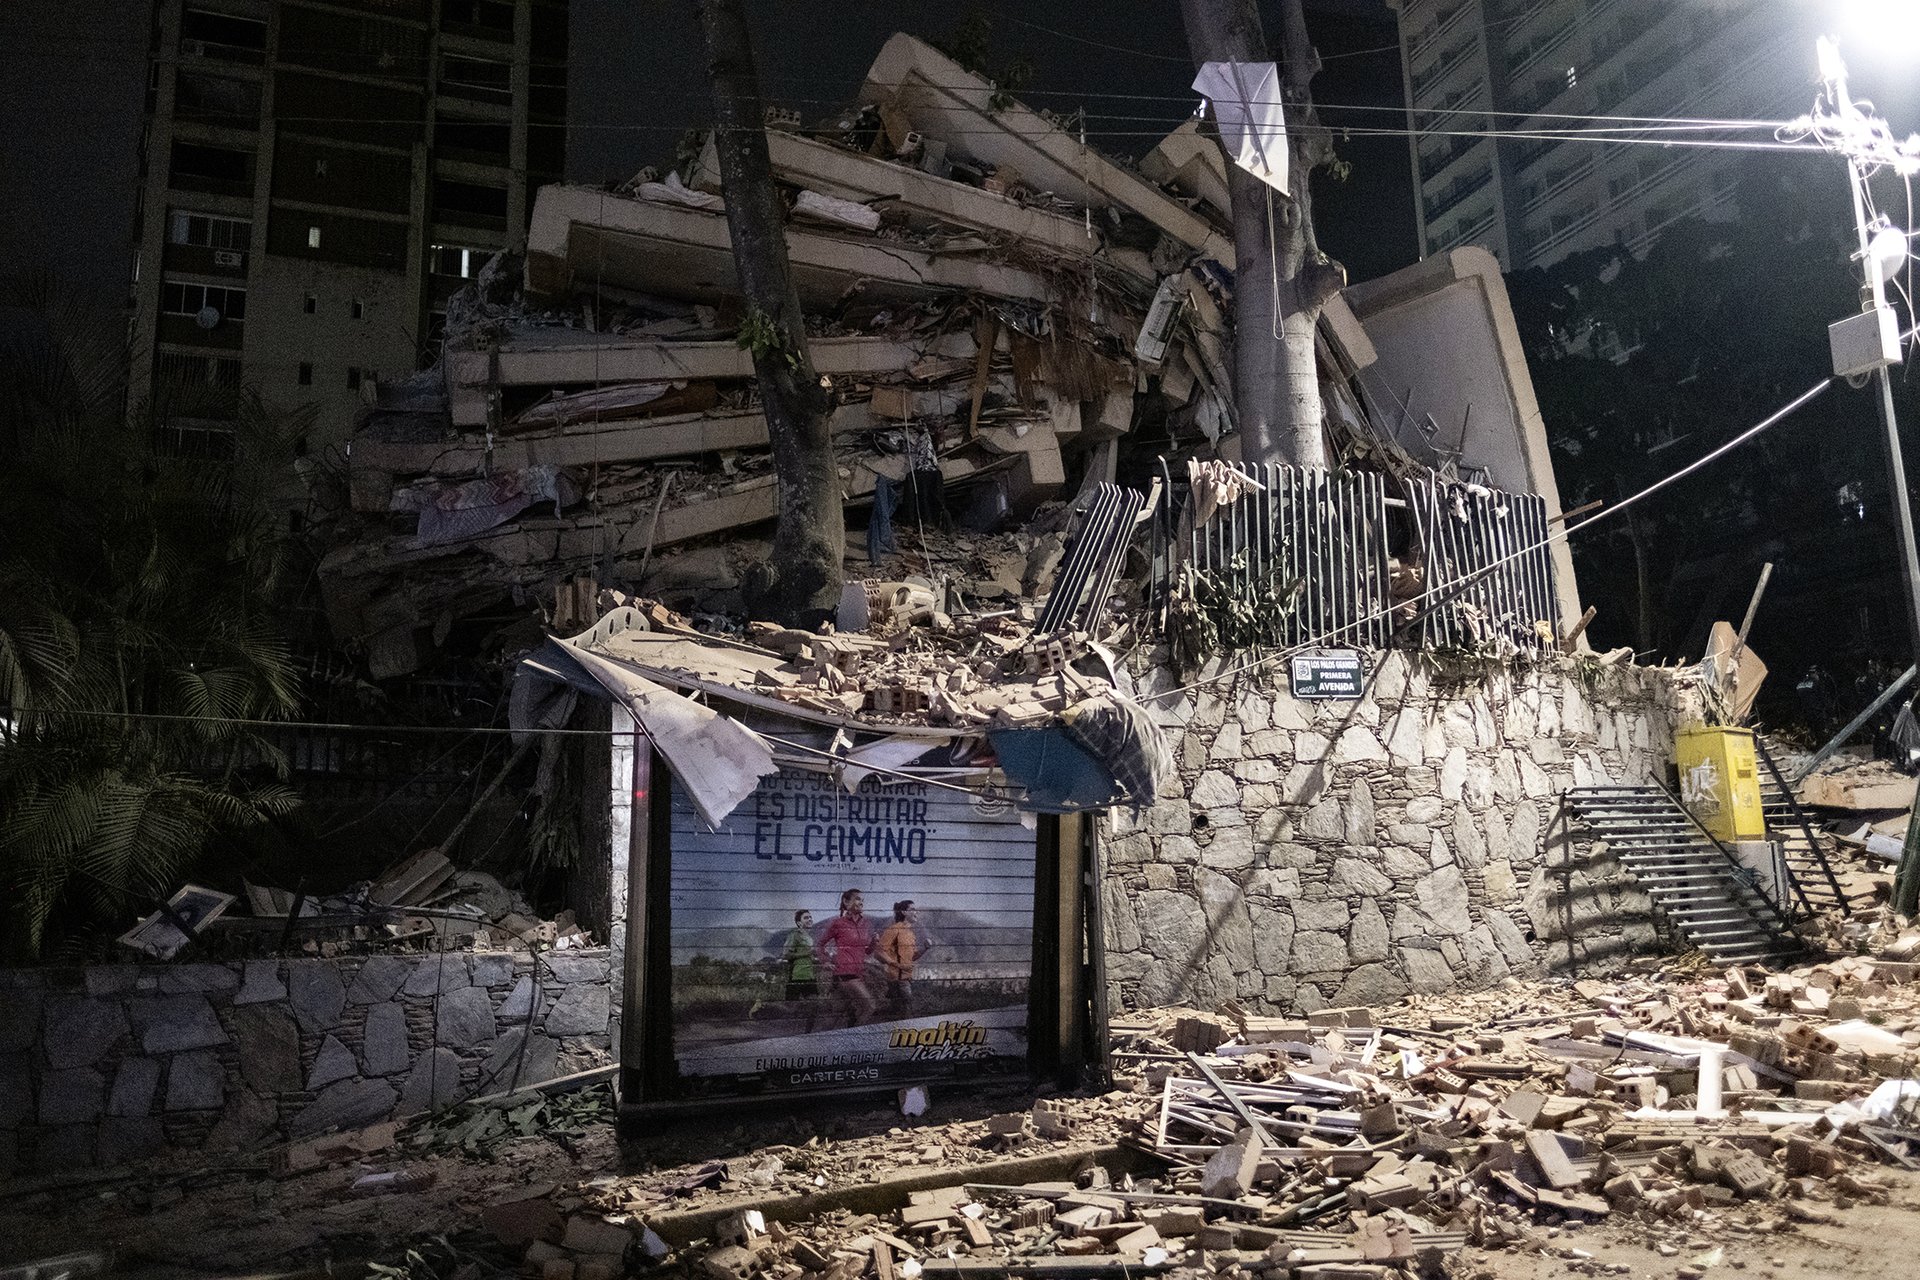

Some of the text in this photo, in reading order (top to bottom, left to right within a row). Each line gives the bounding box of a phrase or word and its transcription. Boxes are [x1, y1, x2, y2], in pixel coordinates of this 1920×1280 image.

[1310, 660, 1359, 669] LOS PALOS GRANDES
[1319, 671, 1352, 679] PRIMERA
[1318, 682, 1355, 691] AVENIDA
[755, 792, 928, 826] ES DISFRUTAR
[755, 822, 793, 861] EL
[755, 1053, 885, 1071] ELIJO LO QUE ME GUSTA
